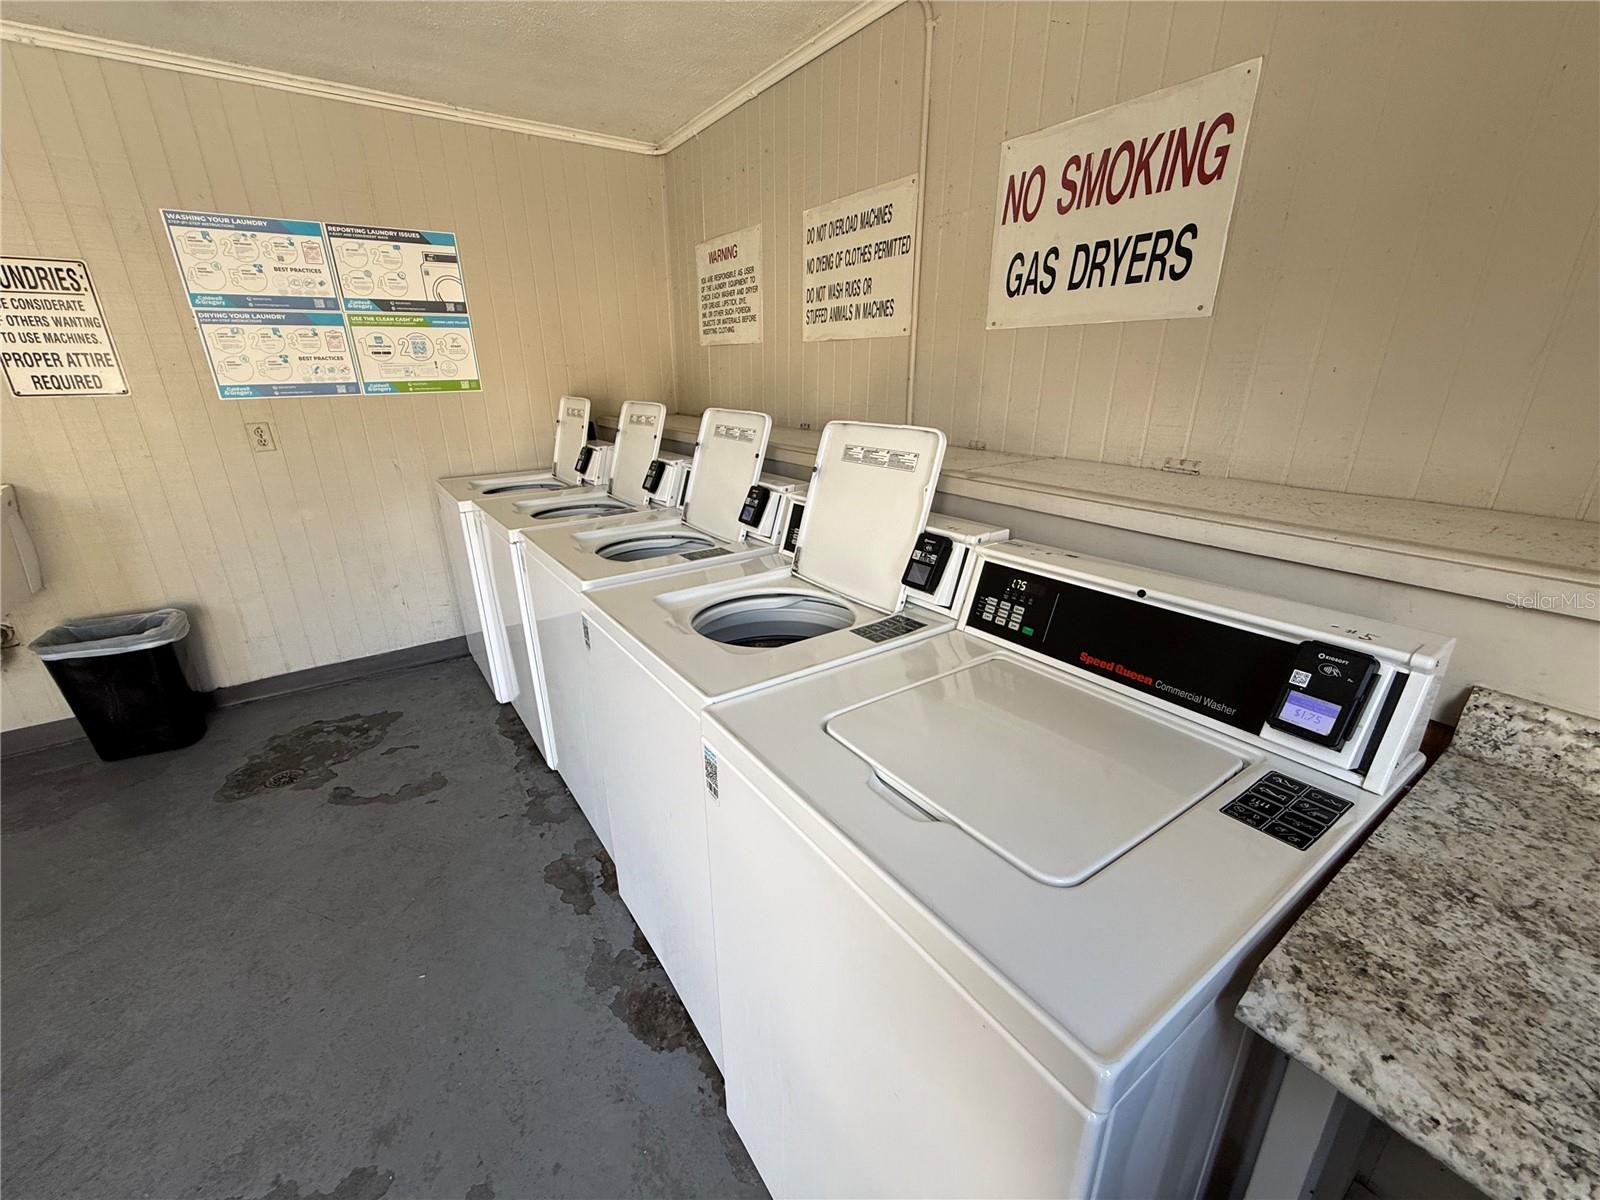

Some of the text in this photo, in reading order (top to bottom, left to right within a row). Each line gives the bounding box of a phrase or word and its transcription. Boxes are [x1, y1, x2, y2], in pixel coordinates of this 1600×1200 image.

[1001, 112, 1235, 225] NO SMOKING
[165, 212, 268, 227] WASHING YOUR LAUNDRY
[806, 203, 893, 245] DO NOT OVERLOAD MACHINES
[327, 226, 366, 234] REPORTING
[367, 228, 397, 237] LAUNDRY
[708, 244, 738, 264] WARNING
[806, 235, 911, 274] NO DYEING OF CLOTHES PERMITTED
[1006, 223, 1198, 298] GAS DRYERS
[289, 266, 322, 274] PRACTICES
[714, 270, 736, 281] RESPONSIBLE
[744, 265, 754, 275] USER
[713, 281, 727, 291] LAUNDRY
[728, 277, 748, 288] EQUIPMENT
[750, 275, 756, 283] TO
[806, 277, 873, 303] DO NOT WASH RUGS OR
[721, 289, 736, 298] WASHER
[745, 285, 758, 294] DRYER
[10, 298, 85, 311] CONSIDERATE
[806, 298, 894, 325] STUFFED ANIMALS IN MACHINES
[6, 314, 50, 328] OTHERS
[51, 316, 101, 328] WANTING
[0, 331, 102, 344] TO USE MACHINES.
[2, 352, 115, 368] PROPER ATTIRE
[30, 374, 103, 390] REQUIRED
[1079, 651, 1237, 716] Speed Queen Commercial Washer
